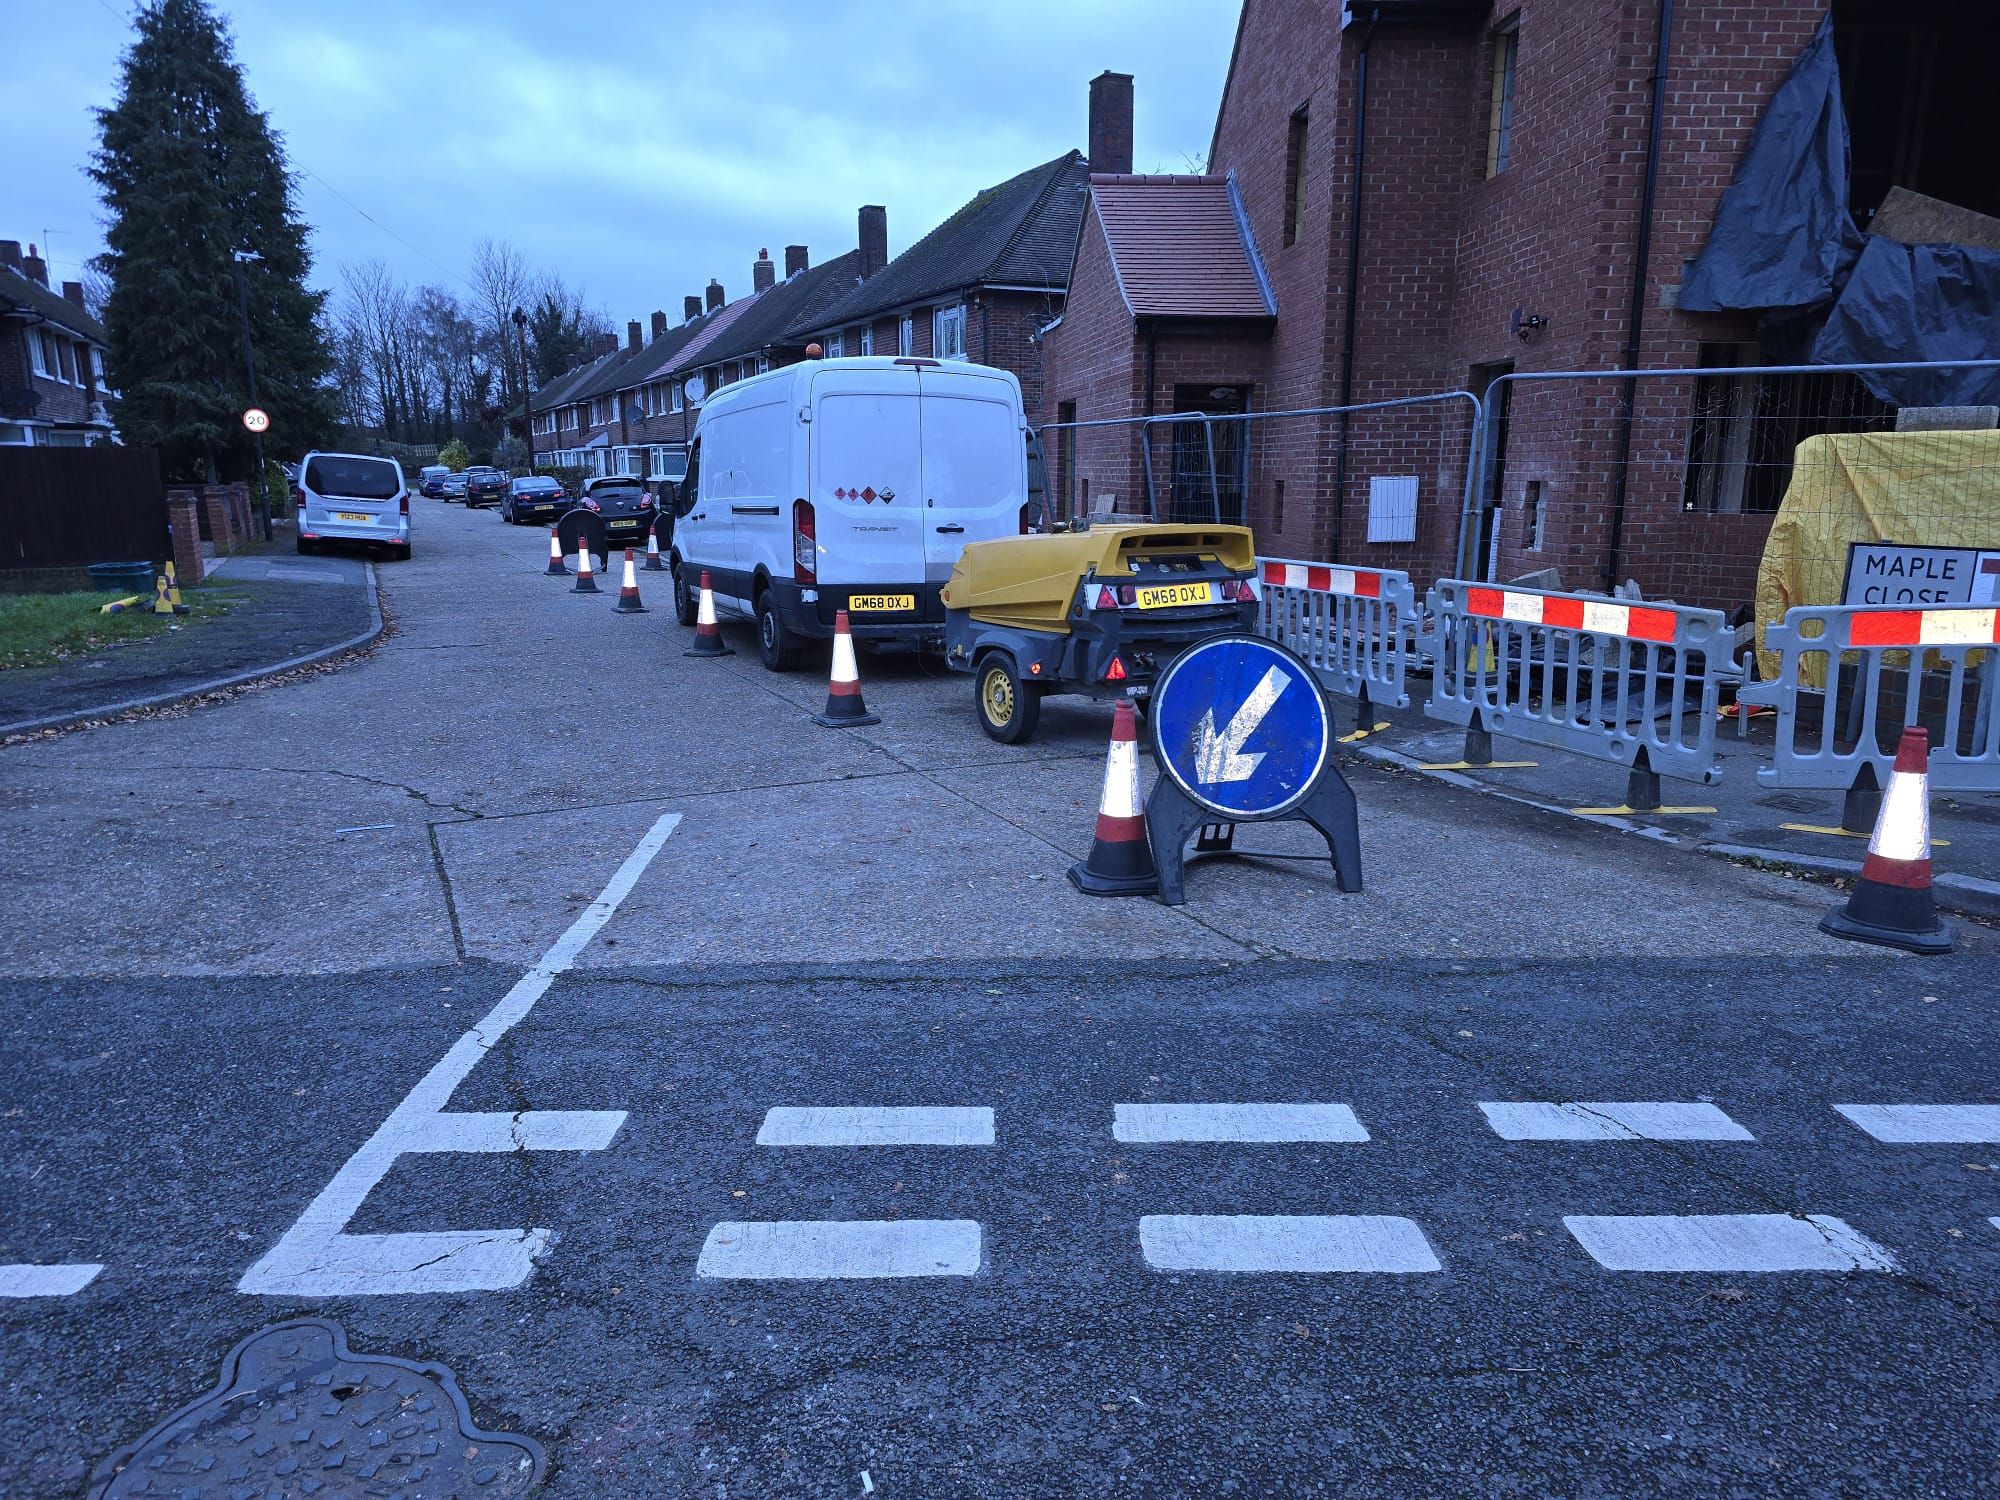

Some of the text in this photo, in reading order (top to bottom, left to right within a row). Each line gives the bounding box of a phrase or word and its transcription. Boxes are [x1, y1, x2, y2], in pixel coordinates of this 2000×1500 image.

[248, 416, 265, 425] 20
[1865, 554, 1958, 580] MAPLE
[854, 597, 909, 609] GM68 OXJ
[1143, 586, 1206, 606] GM68 OXJ
